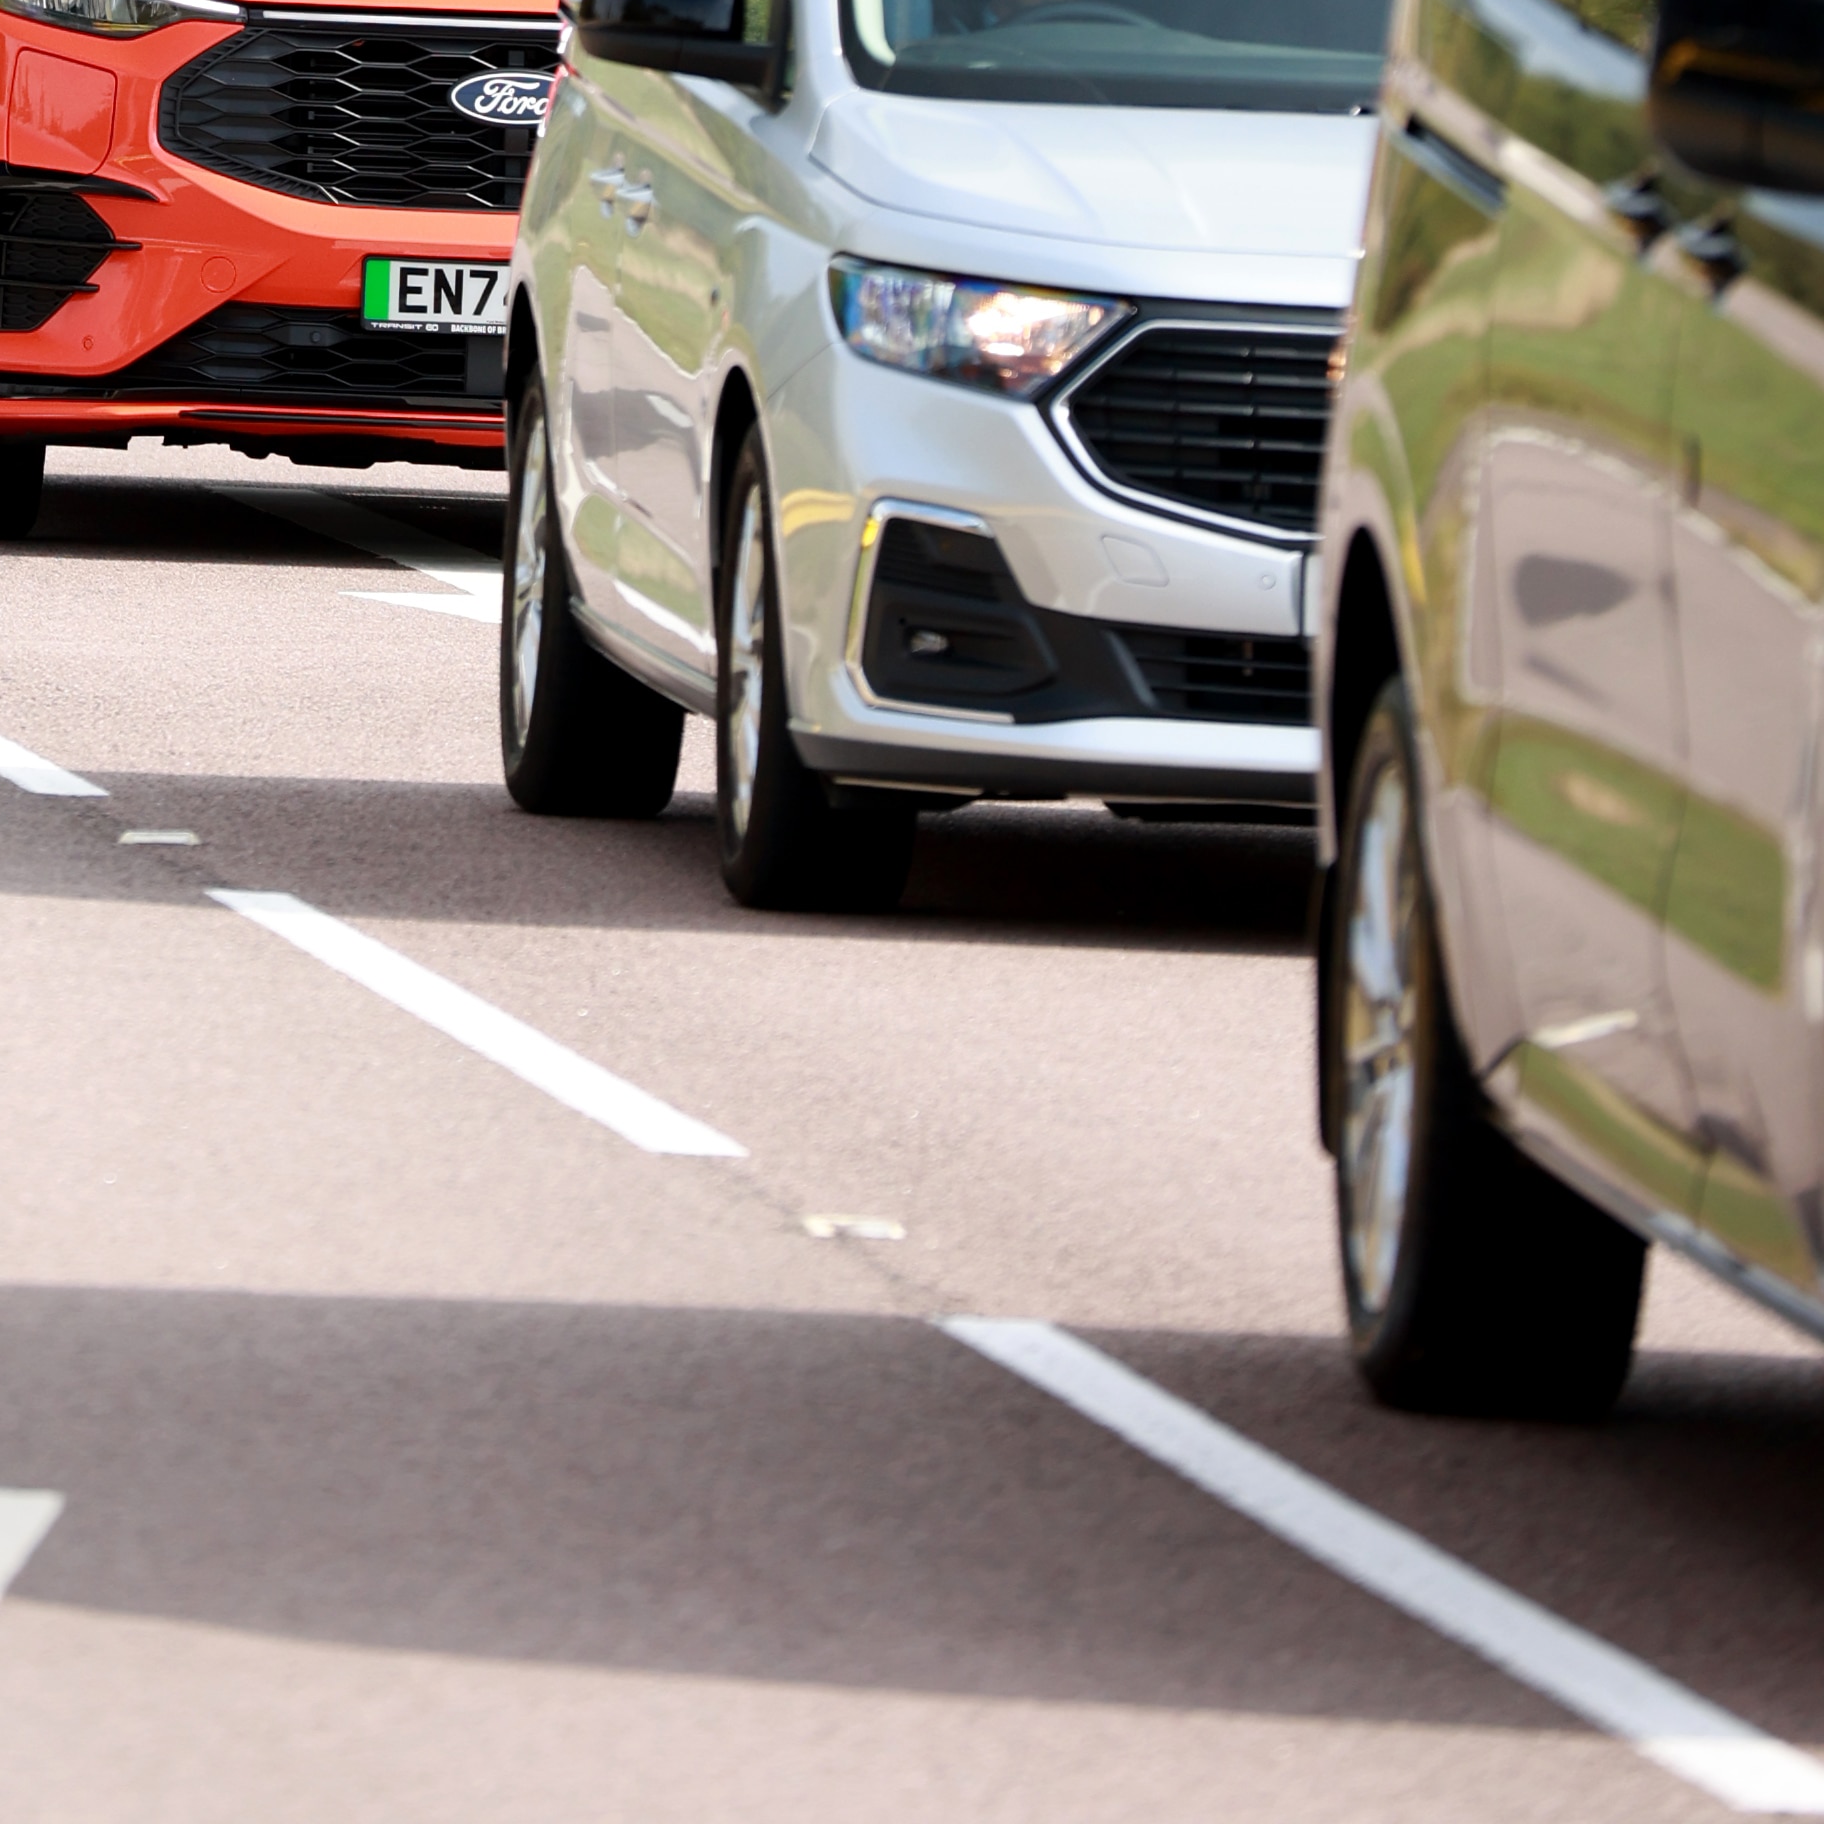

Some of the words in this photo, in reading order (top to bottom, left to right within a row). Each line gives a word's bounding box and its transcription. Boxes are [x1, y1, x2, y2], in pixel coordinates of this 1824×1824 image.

[398, 266, 508, 316] EN7
[370, 321, 424, 331] TRANSIT
[450, 324, 486, 334] BACKBONE
[487, 325, 497, 334] OF
